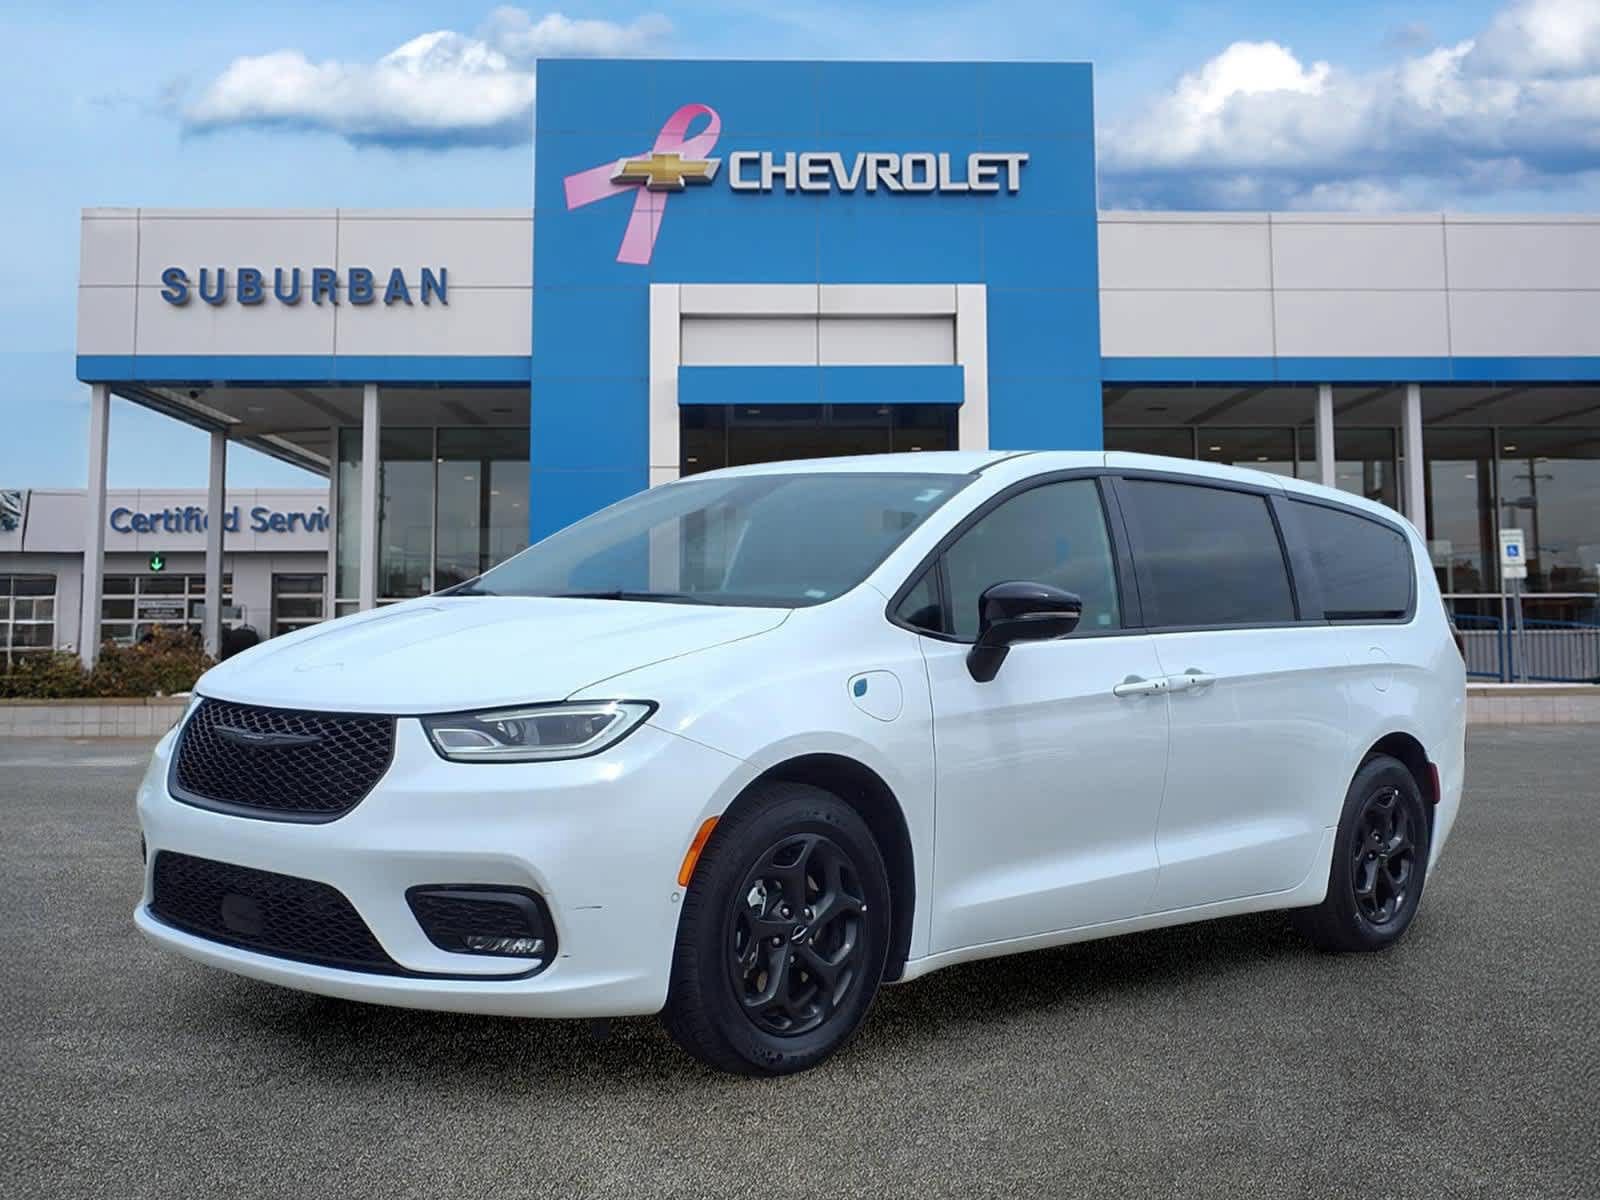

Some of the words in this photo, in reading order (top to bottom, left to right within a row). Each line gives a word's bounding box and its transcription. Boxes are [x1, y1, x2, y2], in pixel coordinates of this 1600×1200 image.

[728, 151, 1029, 193] CHEVROLET
[161, 267, 449, 306] SUBURBAN
[250, 506, 330, 533] Servi
